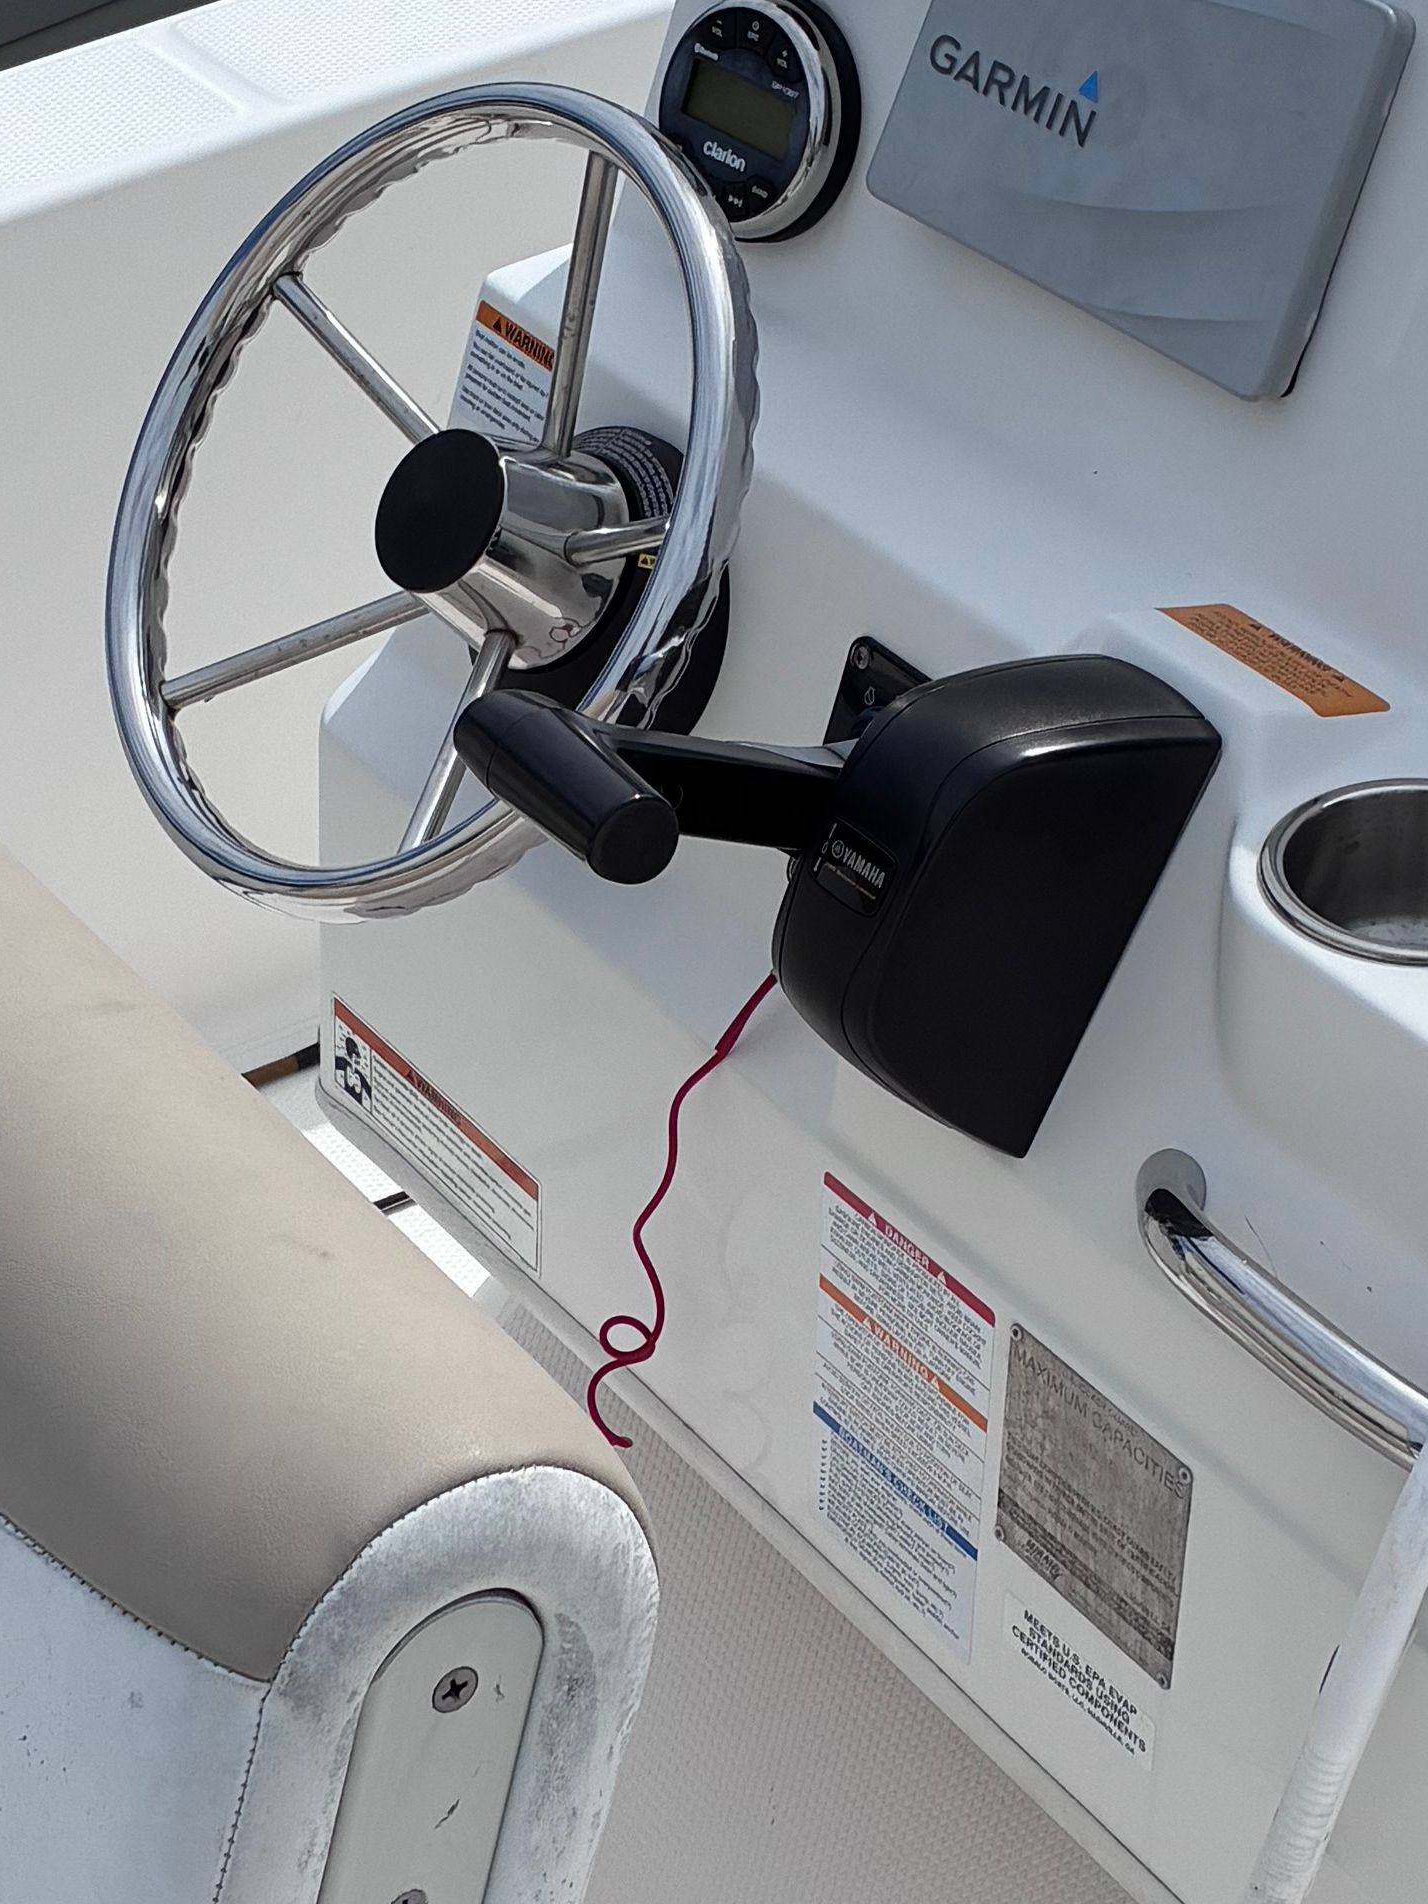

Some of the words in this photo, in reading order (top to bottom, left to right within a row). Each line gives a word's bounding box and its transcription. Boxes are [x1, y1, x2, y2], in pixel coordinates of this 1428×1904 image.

[929, 34, 1098, 148] GARMIN
[702, 140, 747, 173] clarion
[842, 846, 886, 889] YAMAHA
[884, 1223, 930, 1269] DANGER
[871, 1320, 931, 1383] WARNING
[838, 1422, 891, 1482] BOATMAN'S
[892, 1473, 924, 1512] CHECK
[1012, 1345, 1089, 1419] MAXIMUM
[1092, 1411, 1186, 1500] CAPACITIES
[1012, 1625, 1067, 1680] CERTIFIED
[1069, 1677, 1147, 1753] COMPONENTS
[1024, 1609, 1061, 1648] MEETS
[1062, 1643, 1083, 1670] U.S.
[1085, 1664, 1106, 1689] EPA
[1109, 1684, 1138, 1716] EVAP
[1029, 1626, 1093, 1691] STANDARDS
[1095, 1687, 1131, 1724] USING
